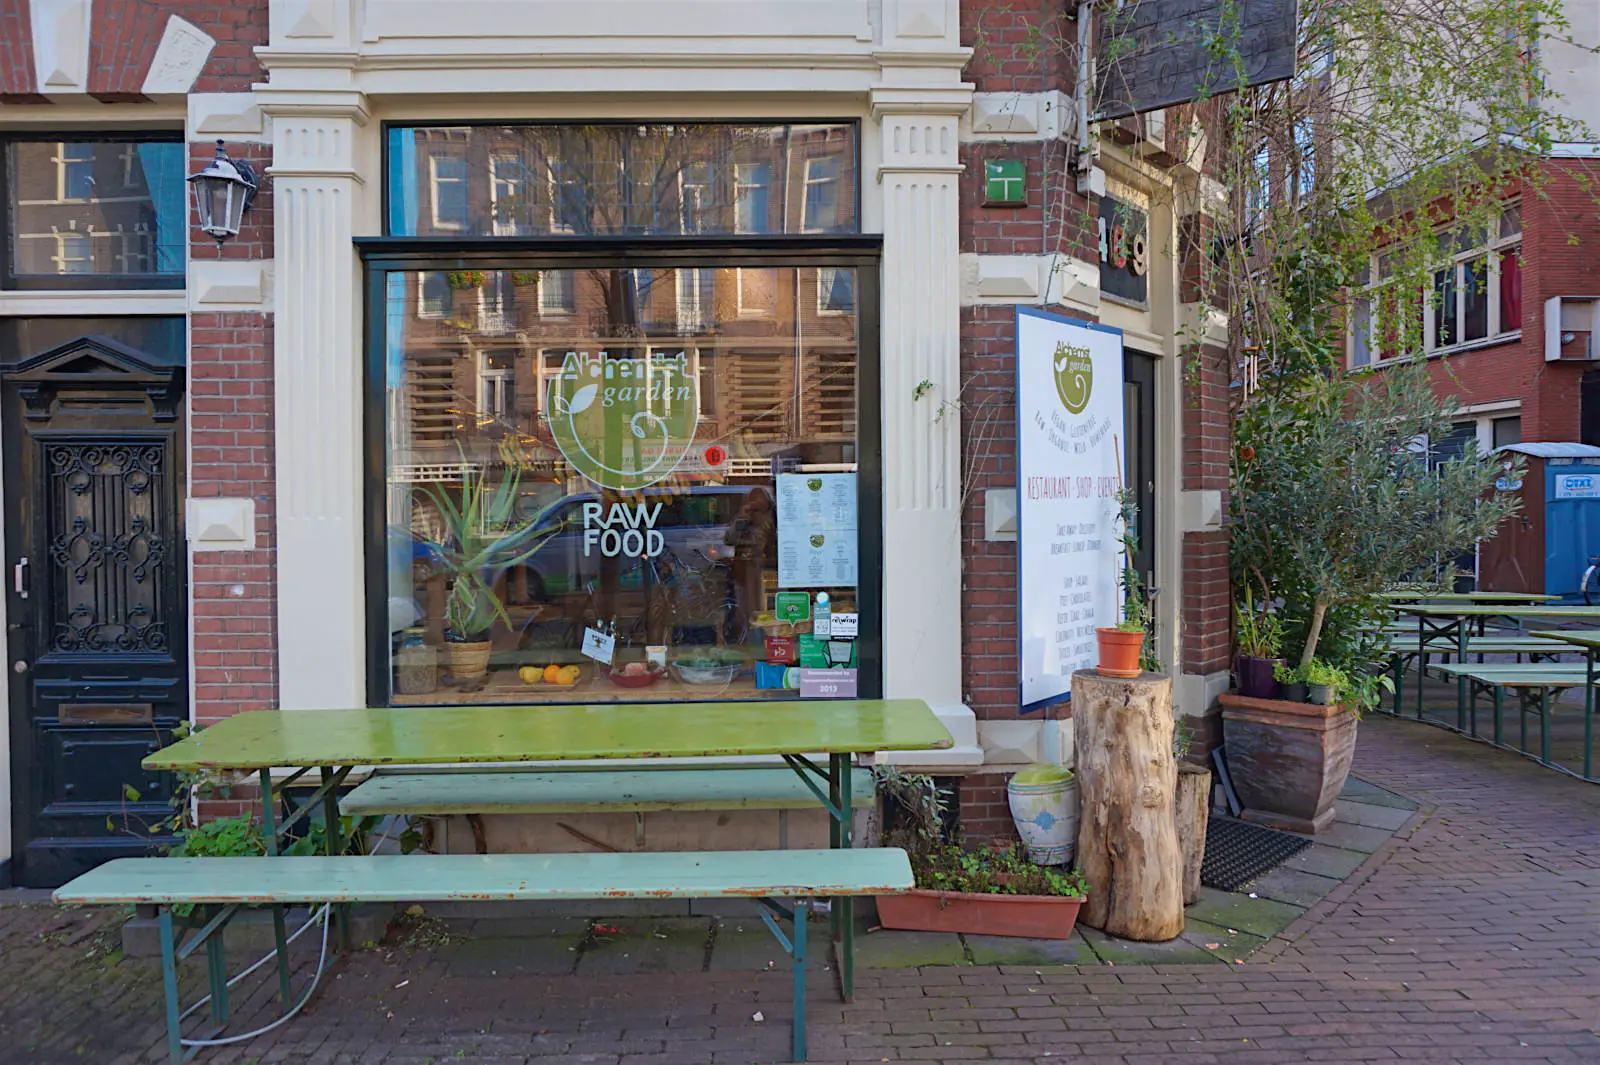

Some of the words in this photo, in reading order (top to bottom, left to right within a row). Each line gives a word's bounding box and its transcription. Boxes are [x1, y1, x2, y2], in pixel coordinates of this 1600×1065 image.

[560, 351, 688, 380] Alchemist
[601, 380, 690, 408] garden
[1027, 476, 1071, 499] RESTAURANT
[1076, 476, 1092, 499] SHOP
[583, 502, 663, 530] RAW
[584, 529, 665, 557] FOOD
